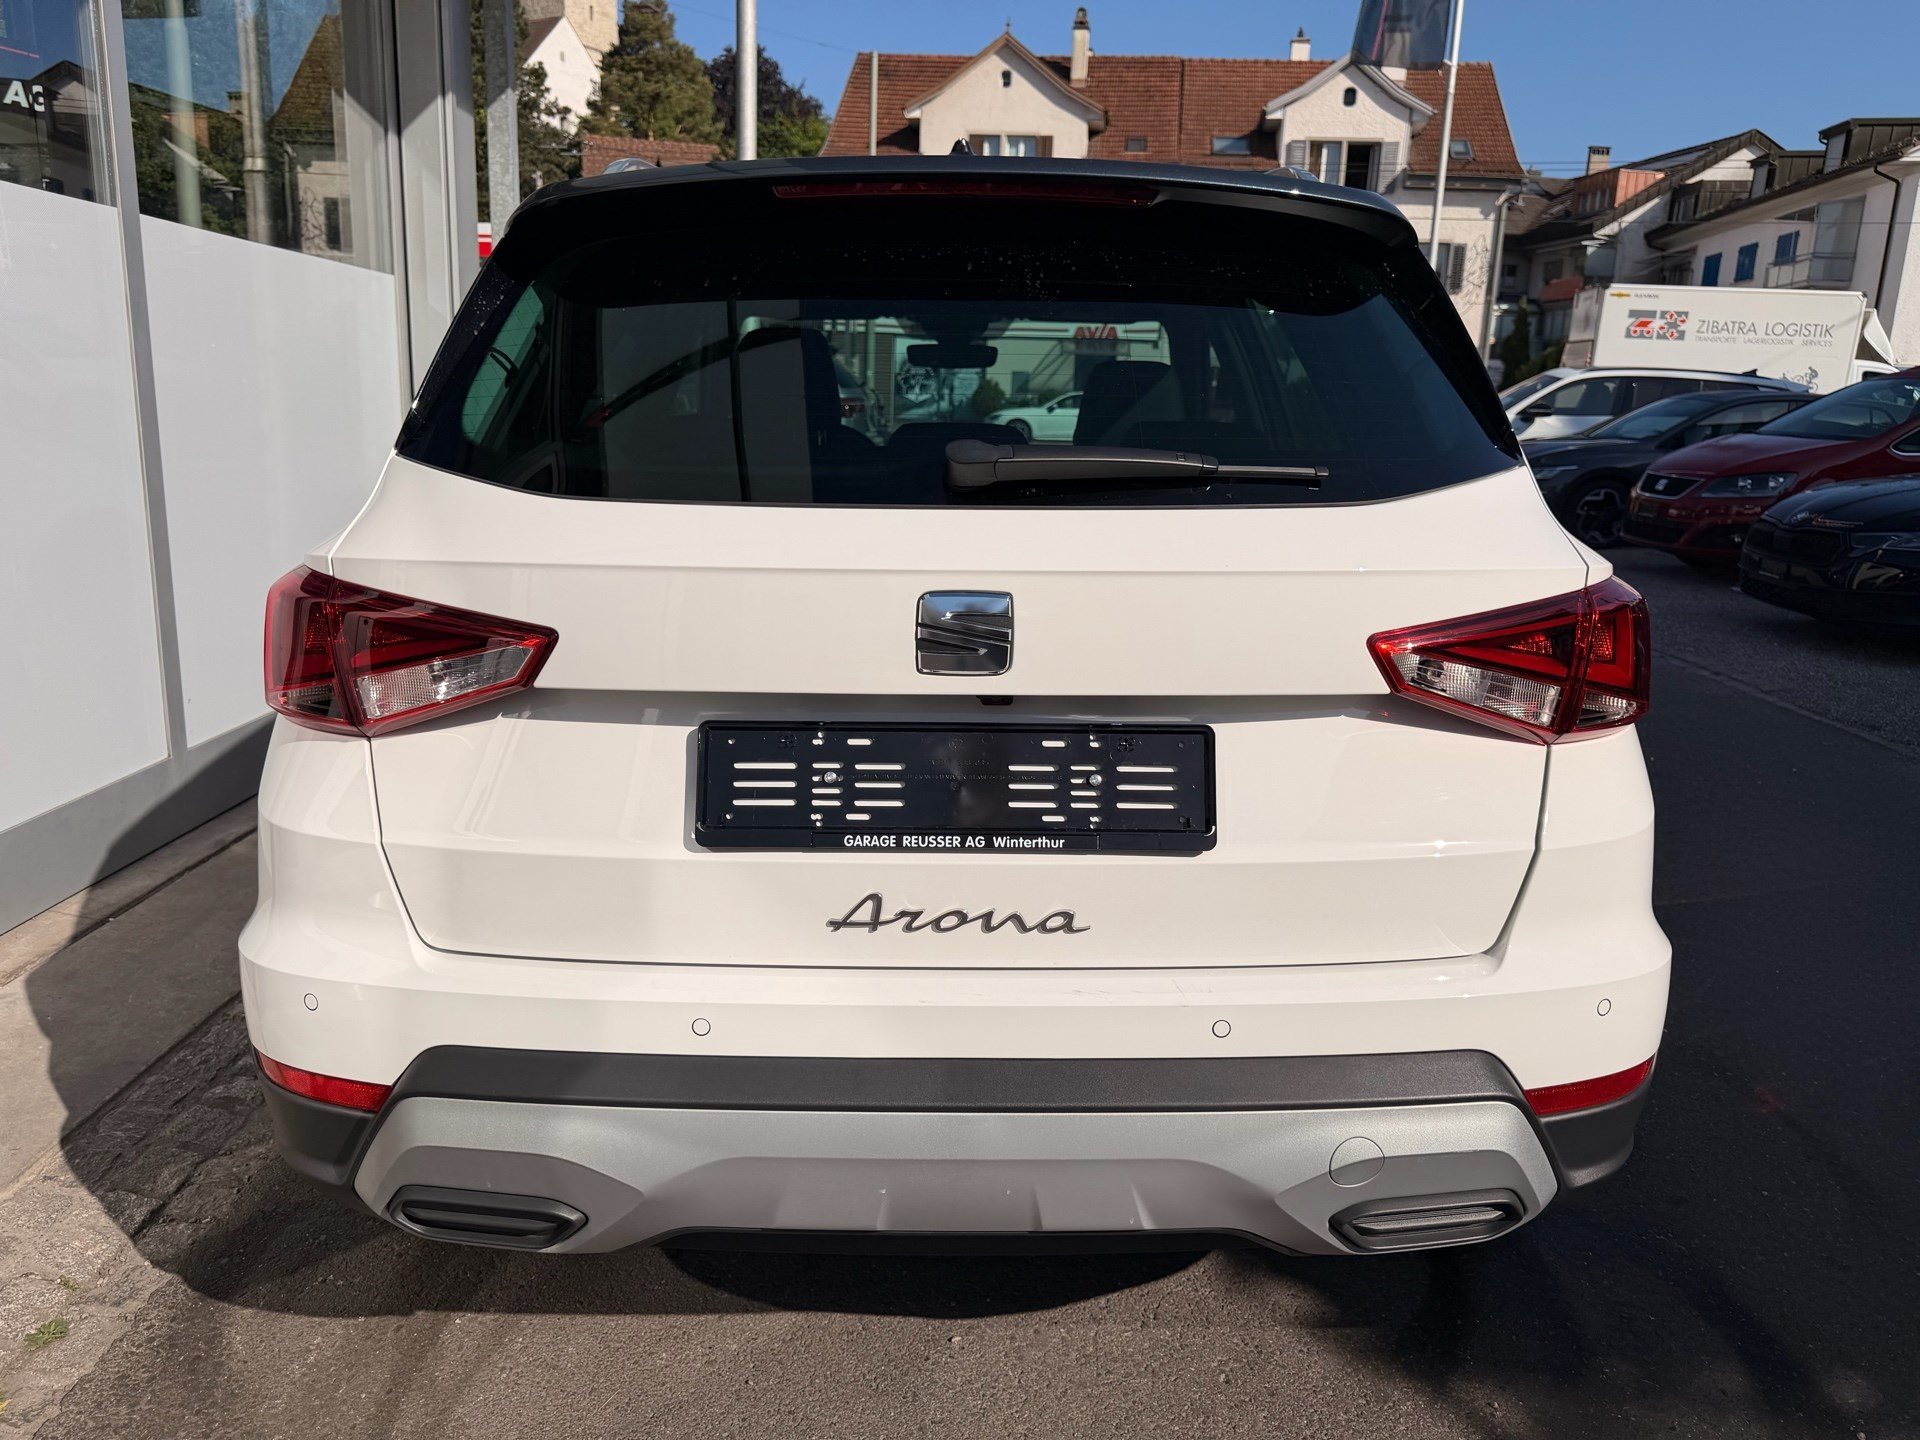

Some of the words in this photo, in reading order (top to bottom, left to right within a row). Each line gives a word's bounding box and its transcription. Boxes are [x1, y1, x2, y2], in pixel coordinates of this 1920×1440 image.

[1073, 326, 1118, 339] AVIA
[1695, 319, 1758, 336] ZIBATRA
[1764, 321, 1836, 339] LOGISTIK
[843, 834, 897, 847] GARAGE
[902, 835, 961, 848] REUSSER
[965, 836, 985, 848] AG
[992, 836, 1065, 848] Winterthur
[826, 892, 1092, 935] Arona
